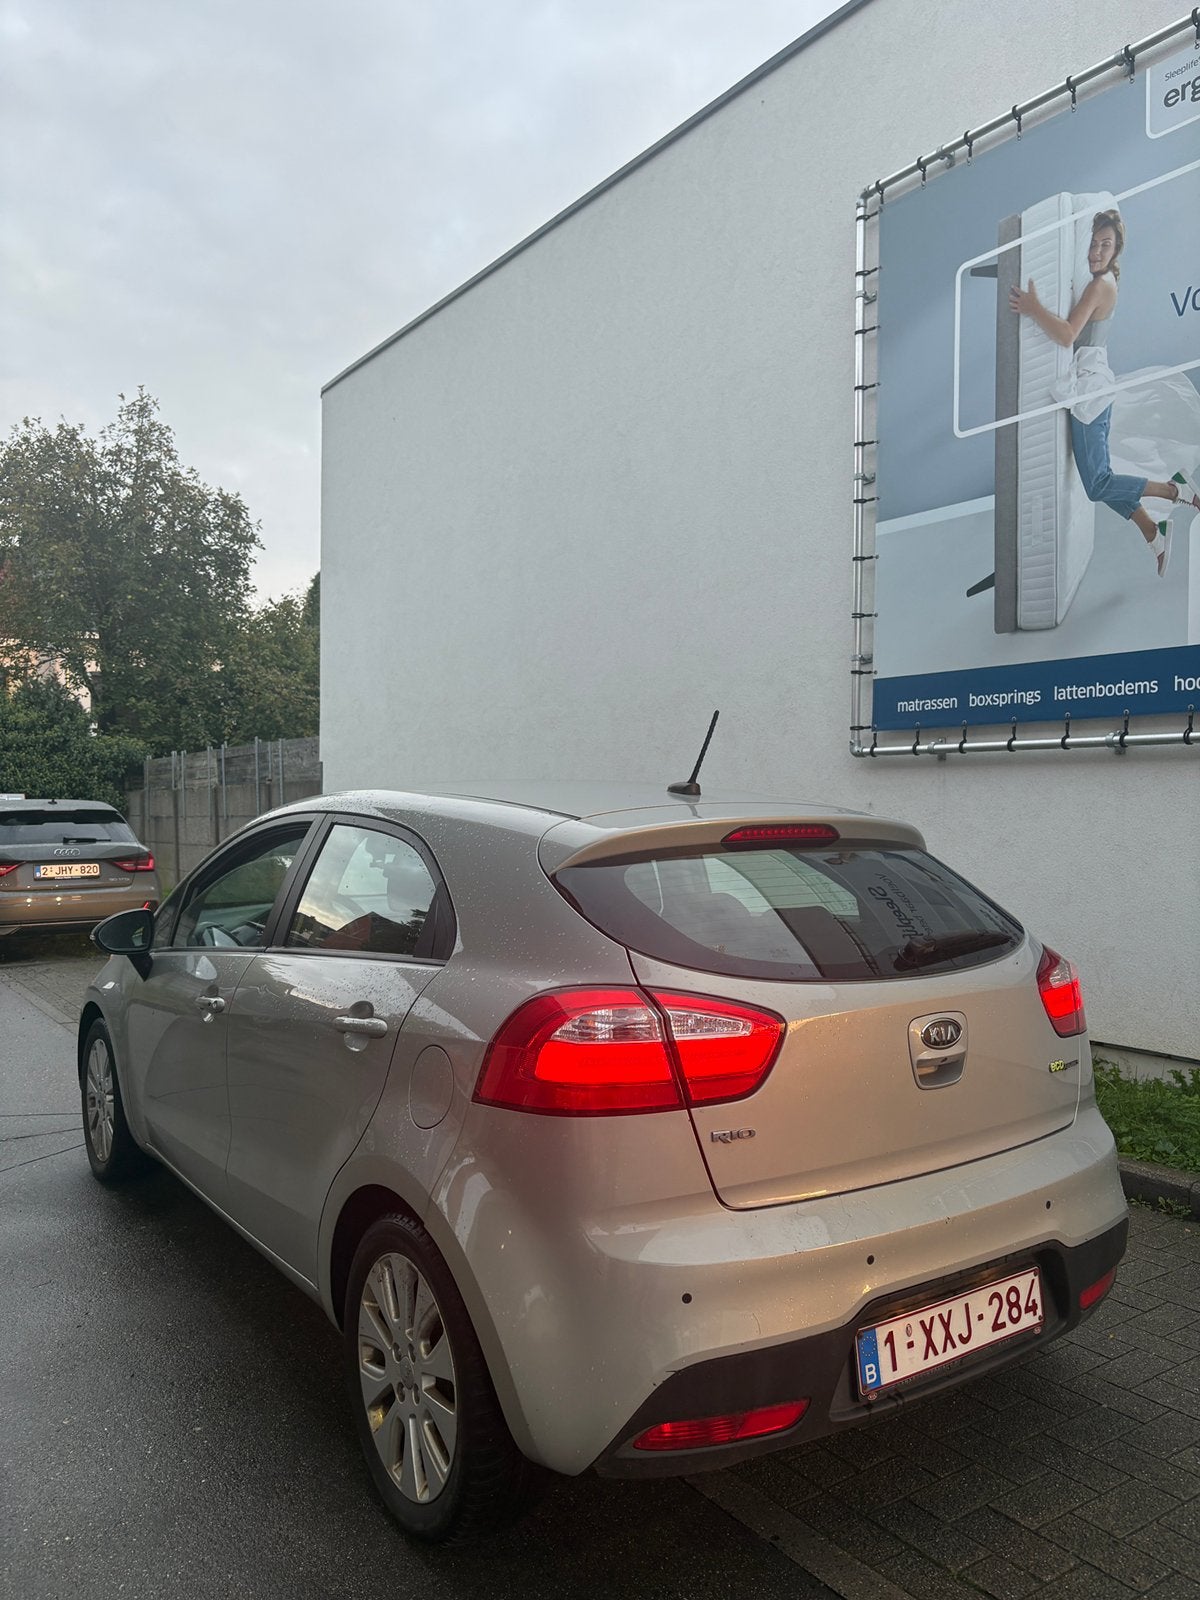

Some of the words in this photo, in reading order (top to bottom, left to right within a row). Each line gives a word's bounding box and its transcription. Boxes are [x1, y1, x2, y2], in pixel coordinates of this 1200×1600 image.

[897, 694, 958, 713] matrassen
[969, 688, 1041, 709] boxsprings
[1053, 678, 1159, 701] lattenbodems
[929, 1023, 958, 1046] KIA
[711, 1128, 756, 1144] RIO
[864, 1363, 877, 1385] B
